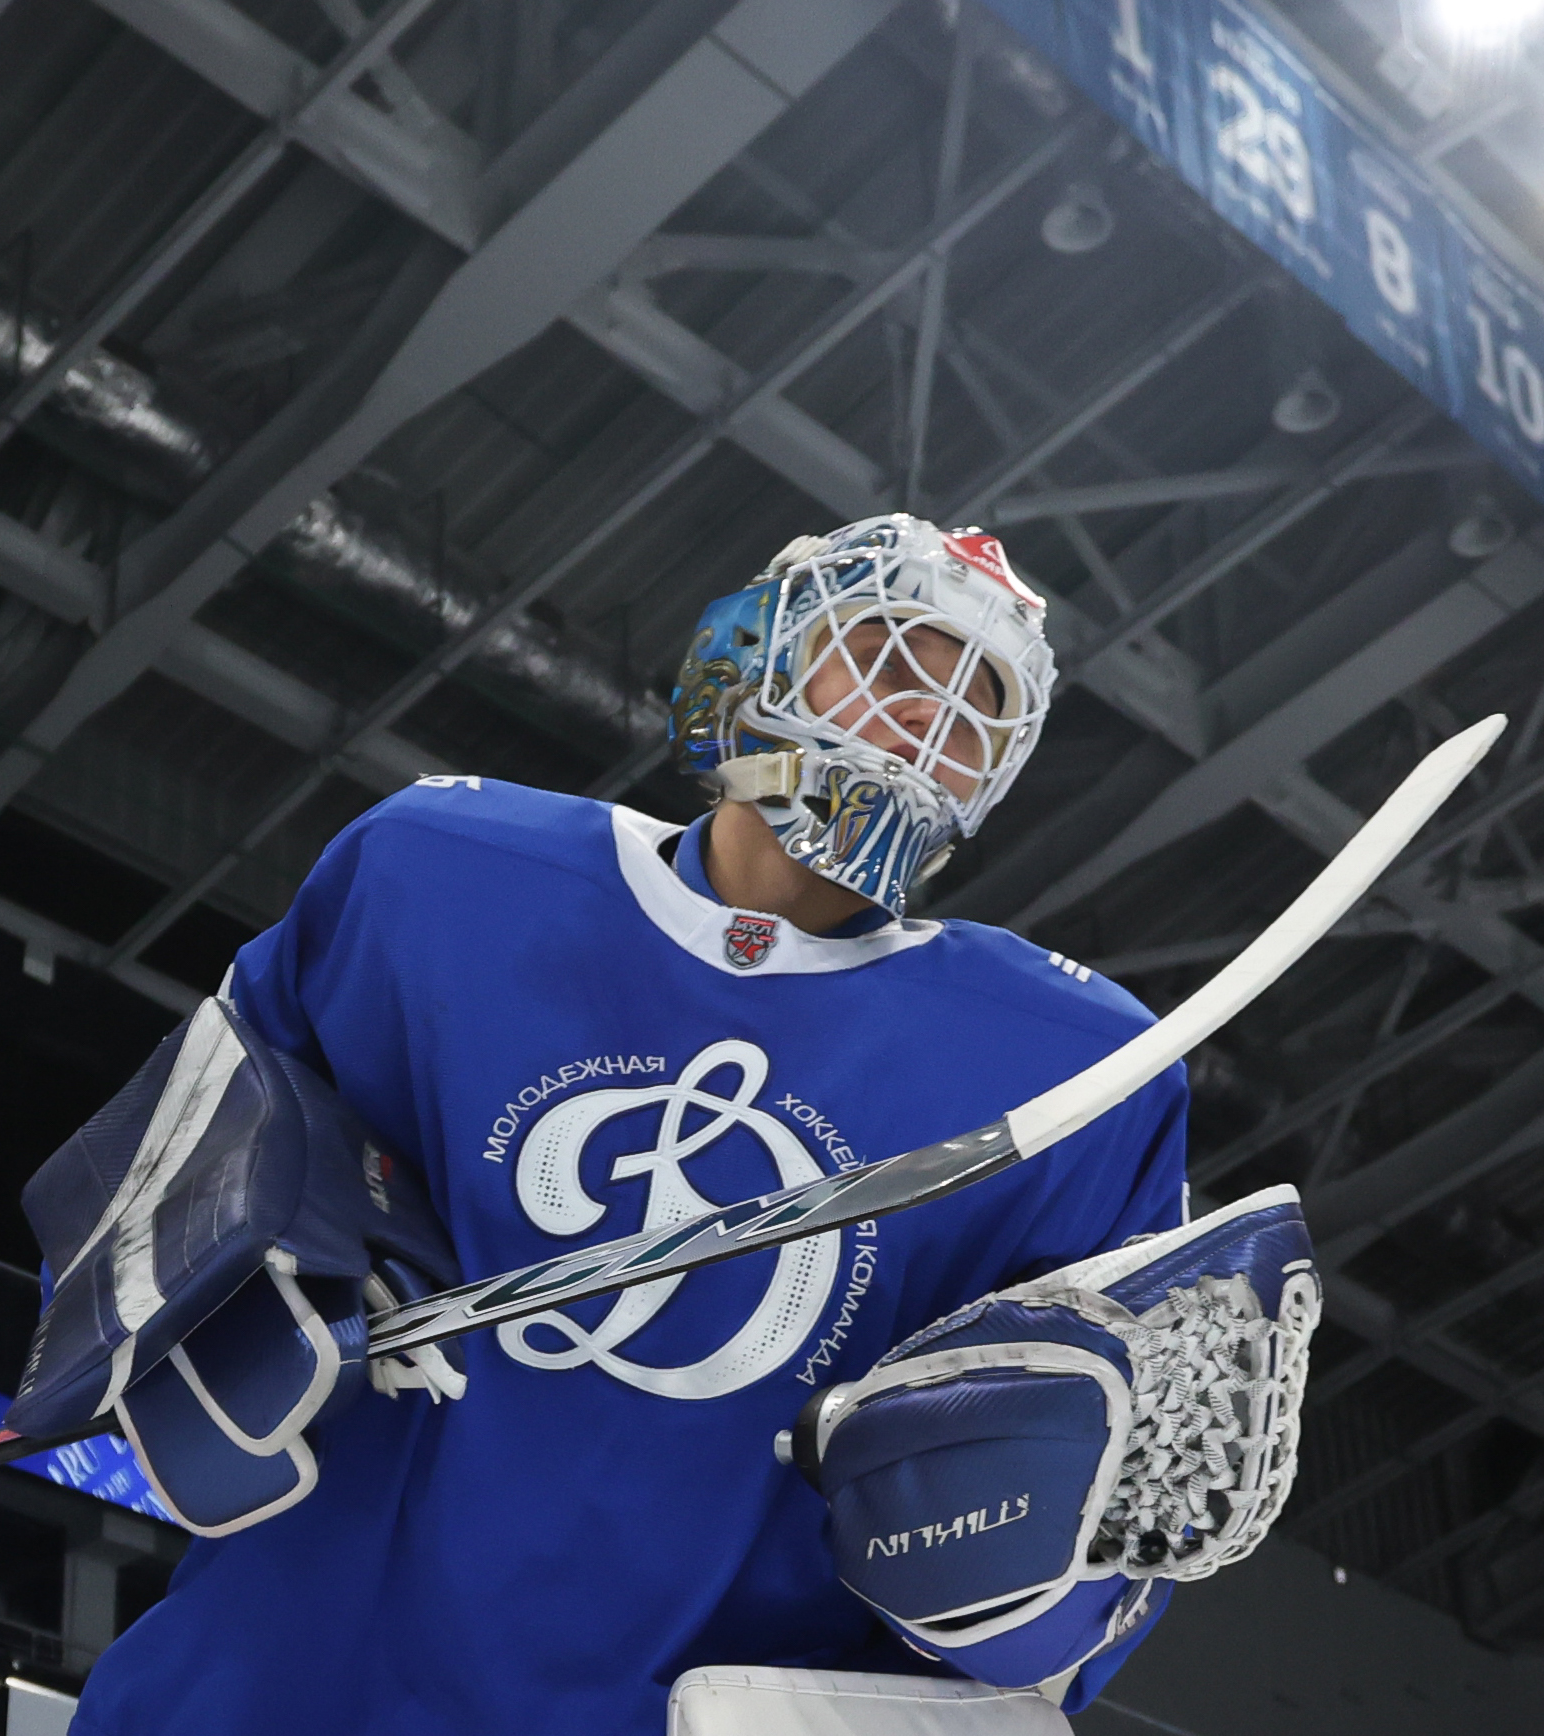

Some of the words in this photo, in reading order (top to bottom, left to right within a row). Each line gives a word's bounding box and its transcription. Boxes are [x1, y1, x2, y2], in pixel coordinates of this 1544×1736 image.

[1364, 208, 1418, 315] 8
[482, 1054, 667, 1164] МОЛОДЕЖНАЯ
[795, 1242, 879, 1387] КОМАНДА
